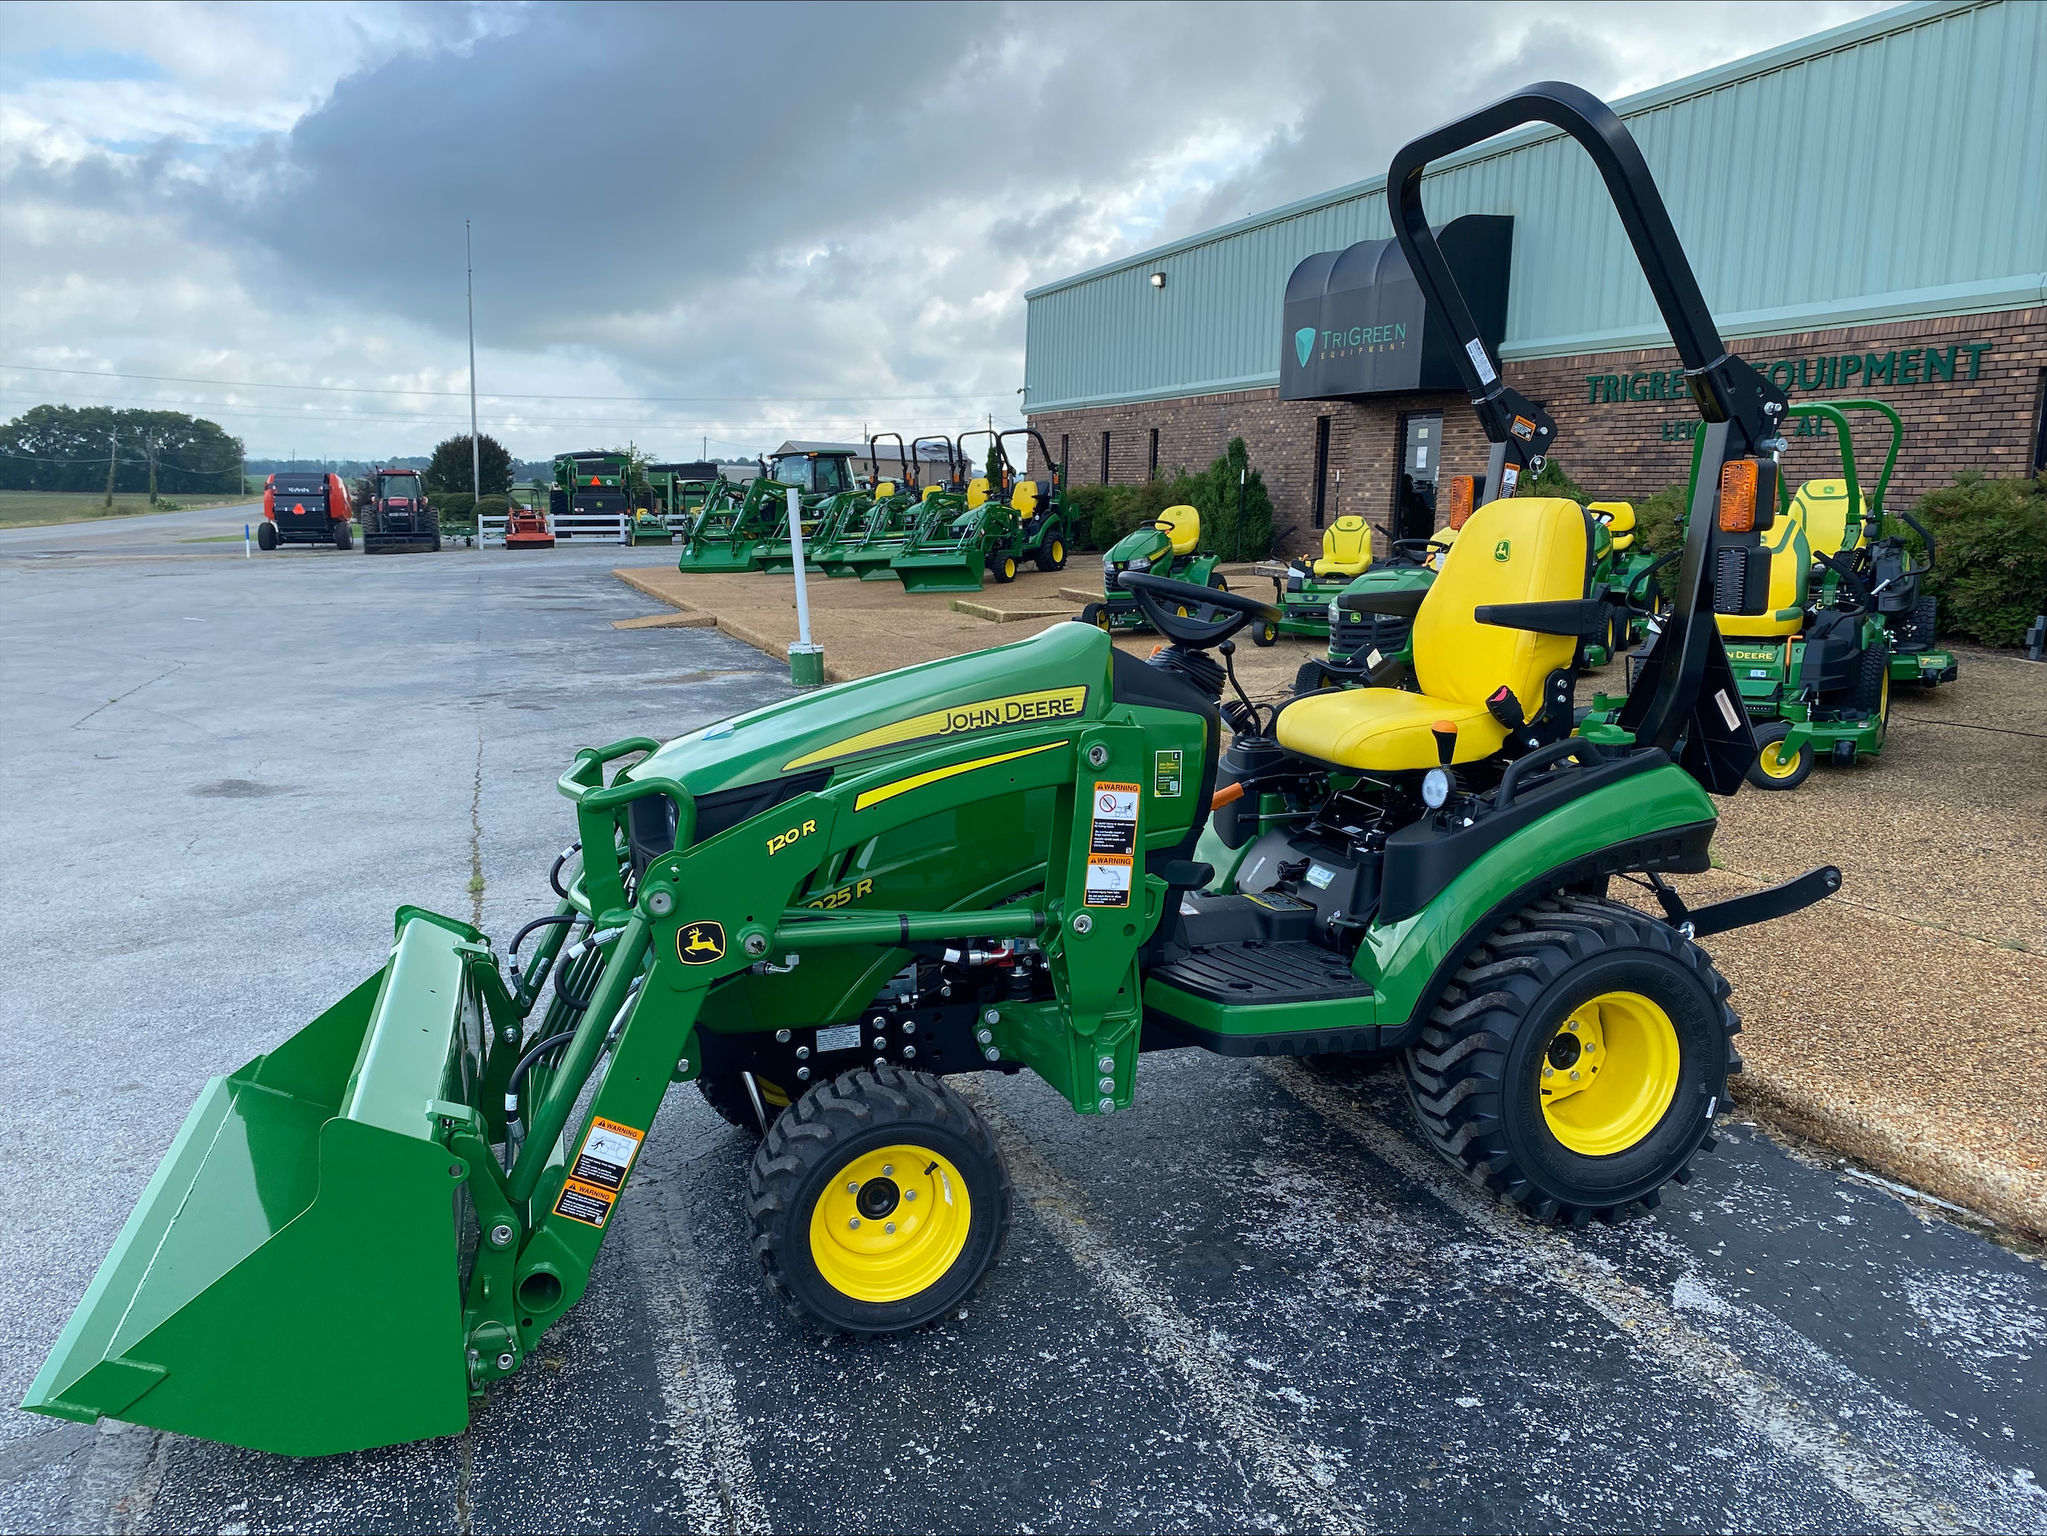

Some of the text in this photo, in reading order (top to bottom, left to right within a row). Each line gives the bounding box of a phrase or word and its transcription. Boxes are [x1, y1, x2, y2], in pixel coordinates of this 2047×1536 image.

[1321, 341, 1406, 360] EQUIPMENT
[1736, 650, 1773, 660] DEERE
[939, 697, 1076, 734] JOHN DEERE
[1103, 783, 1138, 792] WARNING
[765, 819, 817, 857] 120 R
[1097, 857, 1131, 865] WARNING
[856, 877, 874, 899] R
[606, 1122, 638, 1138] WARNING
[578, 1185, 611, 1201] WARNING
